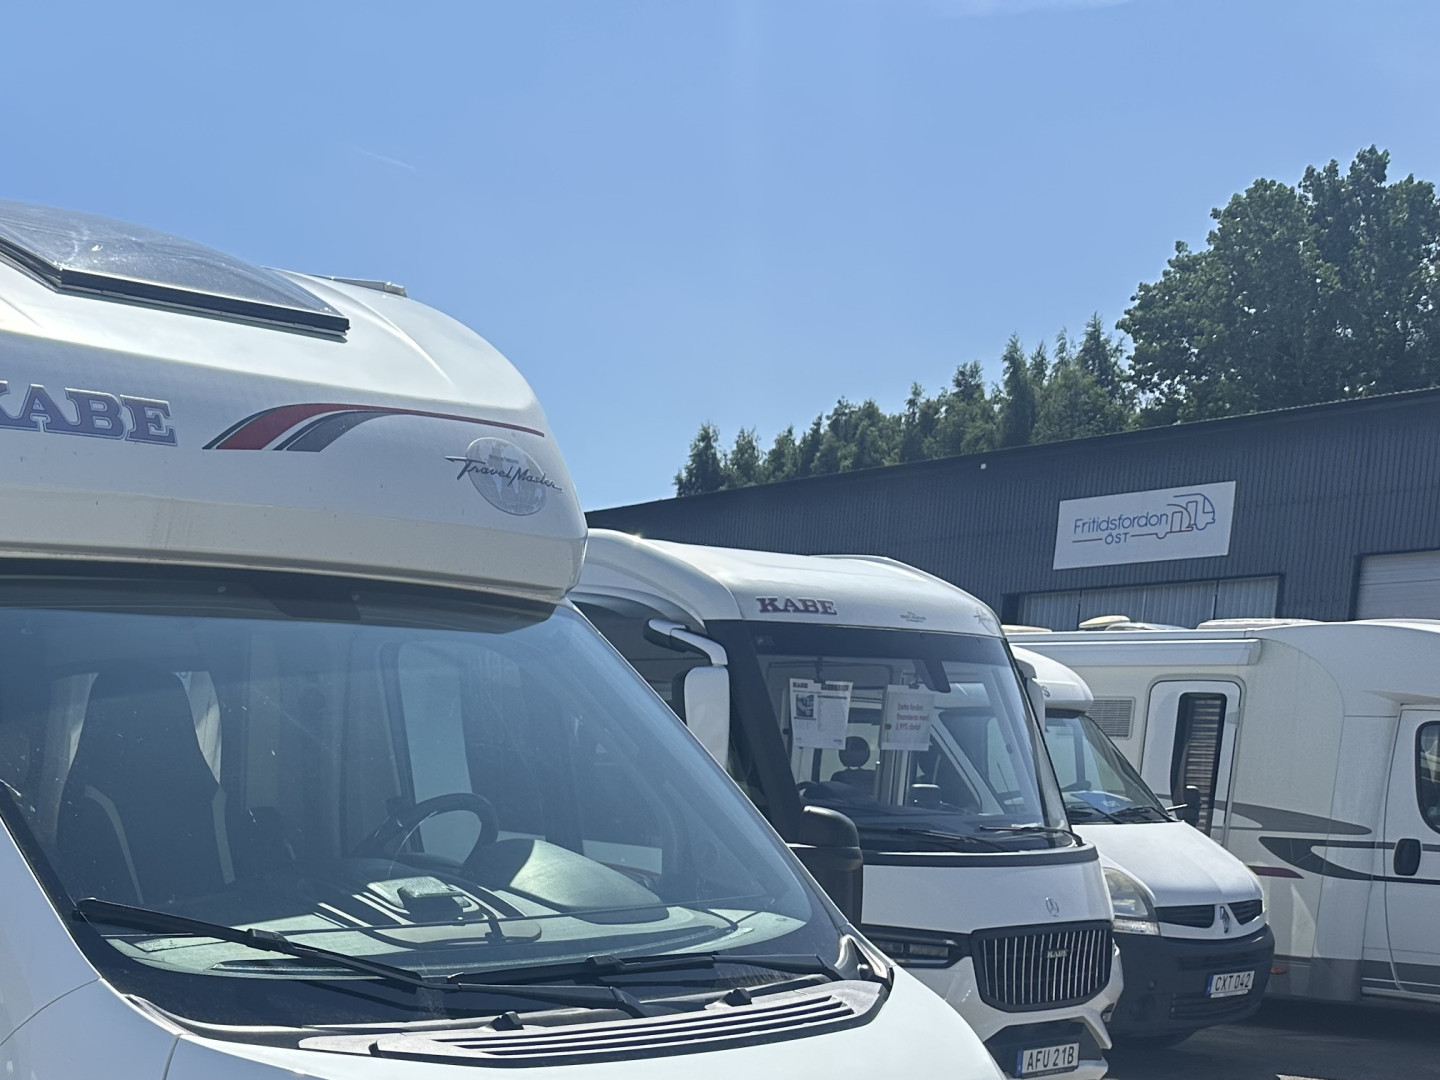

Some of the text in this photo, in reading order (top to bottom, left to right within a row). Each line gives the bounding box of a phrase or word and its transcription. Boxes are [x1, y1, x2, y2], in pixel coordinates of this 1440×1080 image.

[1073, 511, 1169, 535] Fritidsfordon
[756, 597, 837, 616] KABE
[1215, 973, 1251, 991] CXT 042
[1026, 1046, 1075, 1071] AFU 21B
